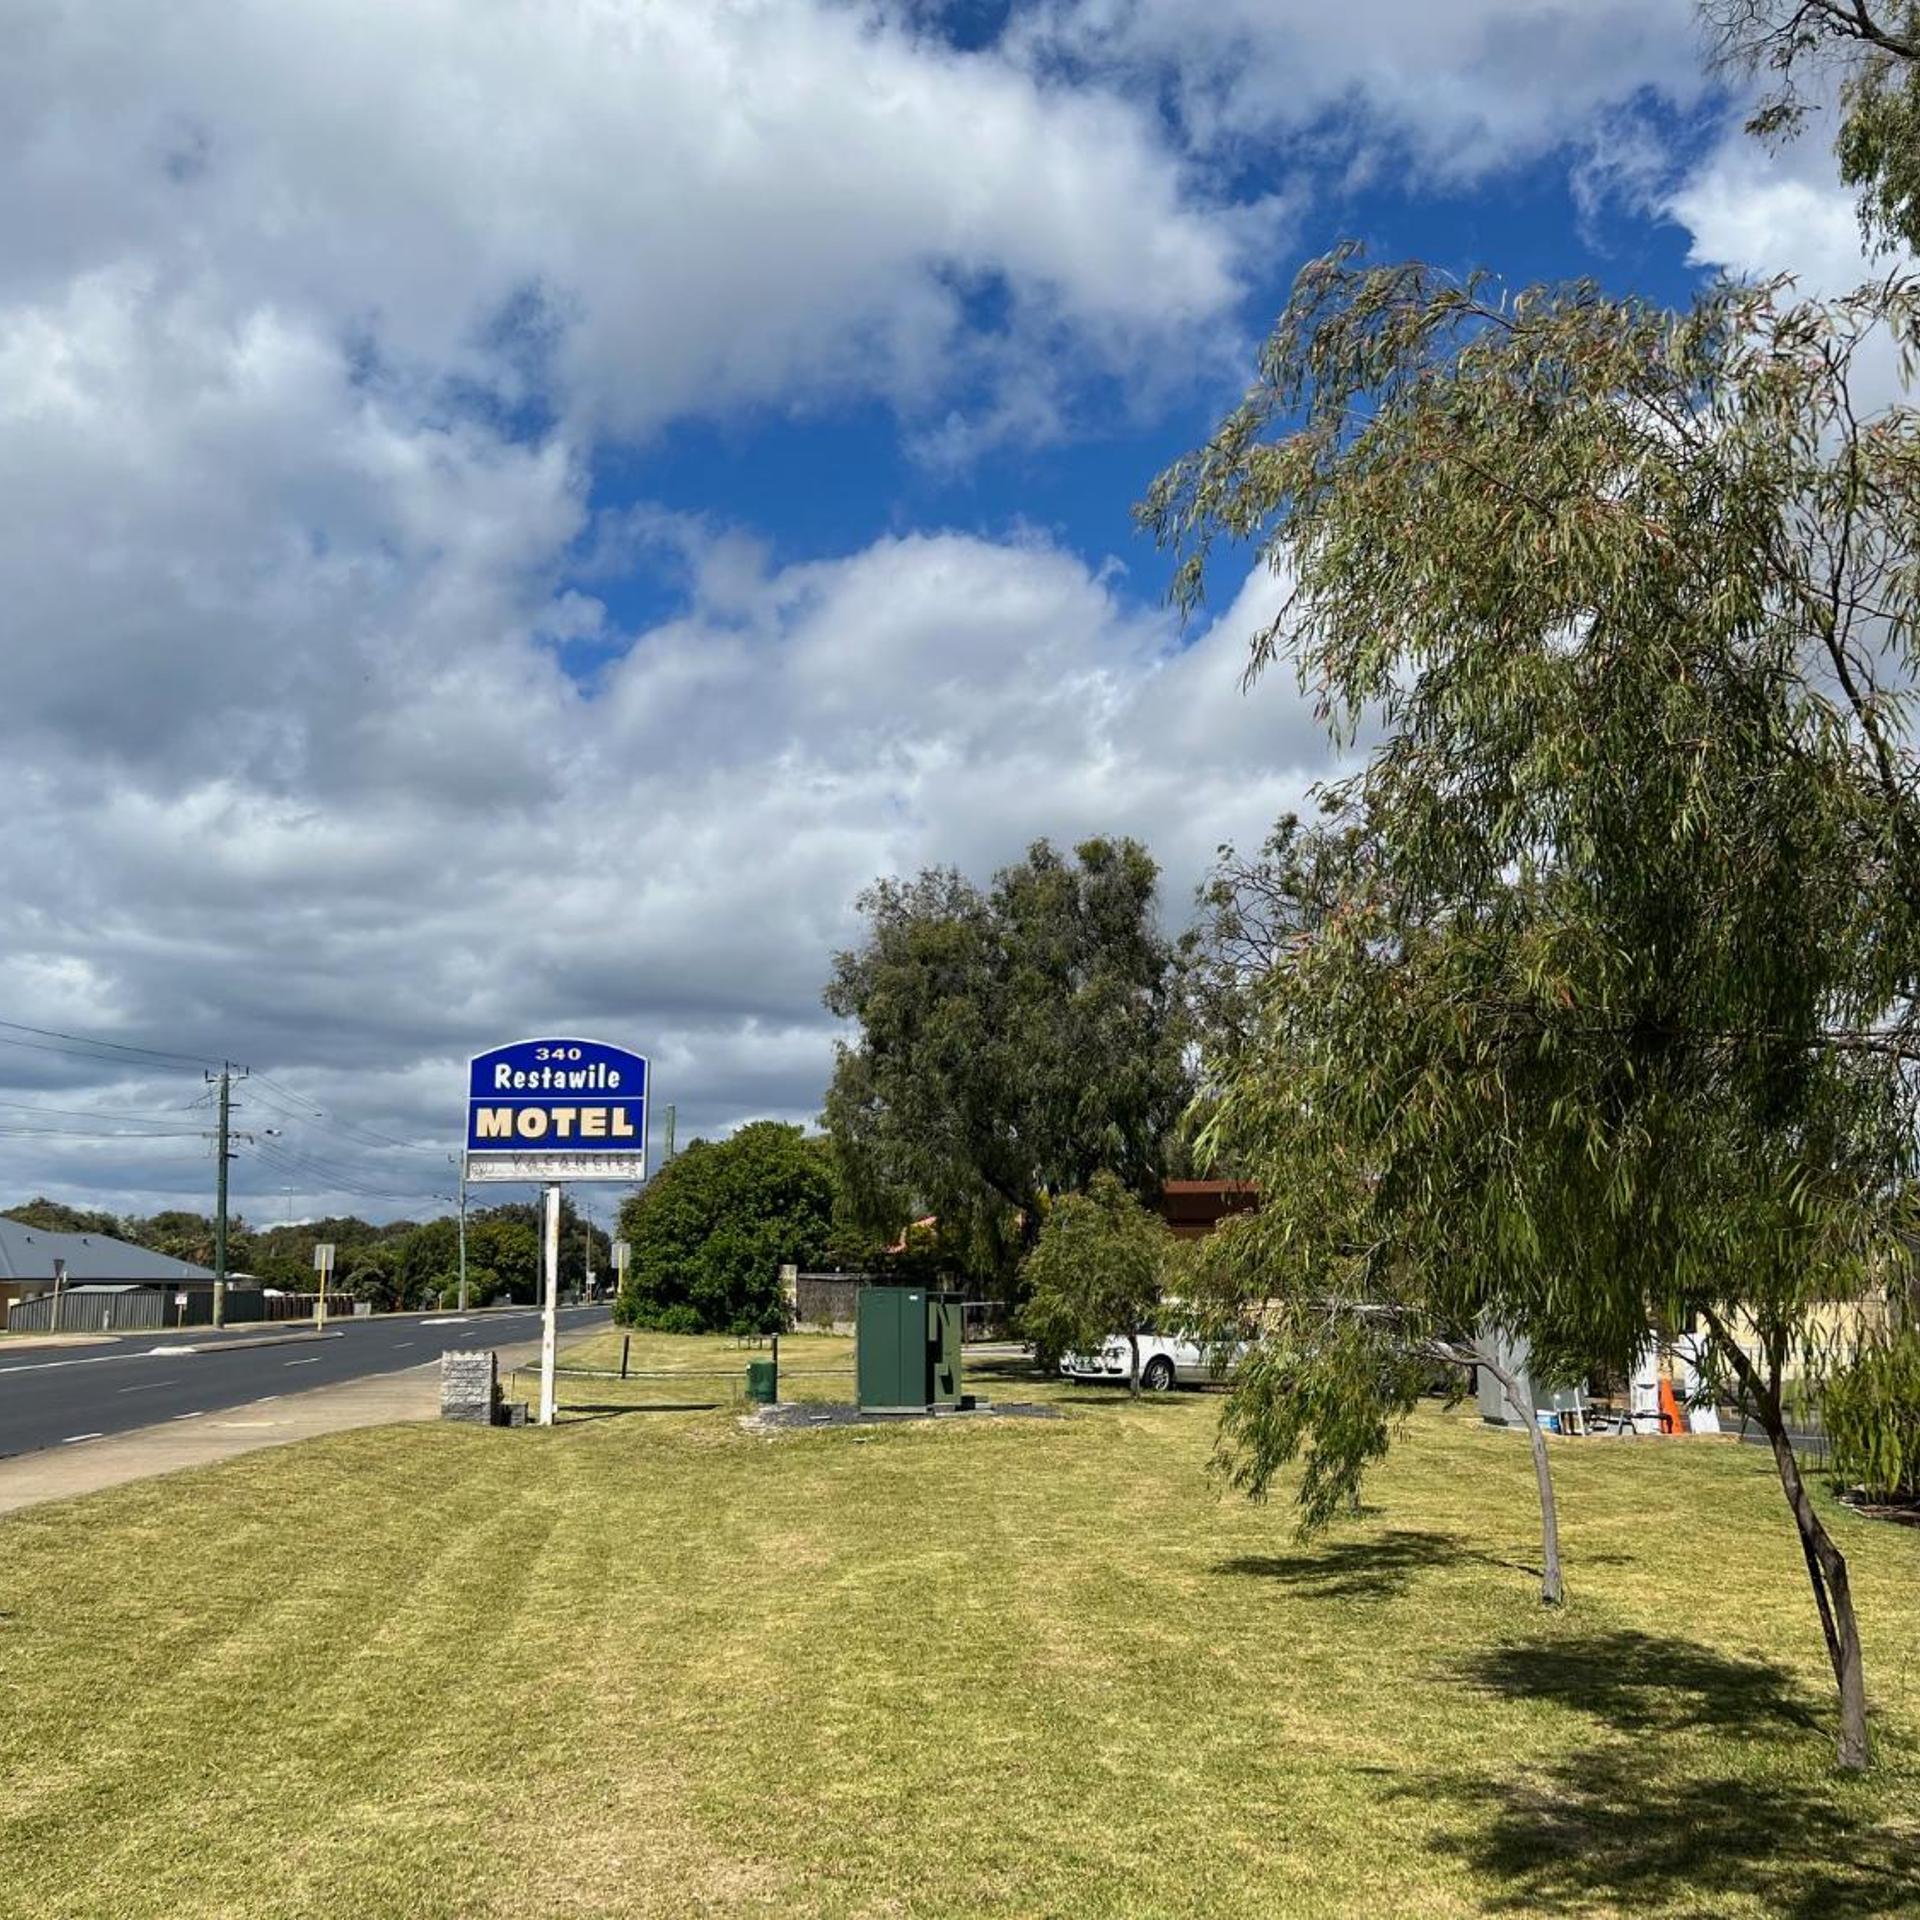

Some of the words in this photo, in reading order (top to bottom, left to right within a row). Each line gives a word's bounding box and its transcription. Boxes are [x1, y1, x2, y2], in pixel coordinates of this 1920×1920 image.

[535, 1047, 582, 1061] 340
[494, 1062, 621, 1089] Restawile
[475, 1107, 634, 1138] MOTEL
